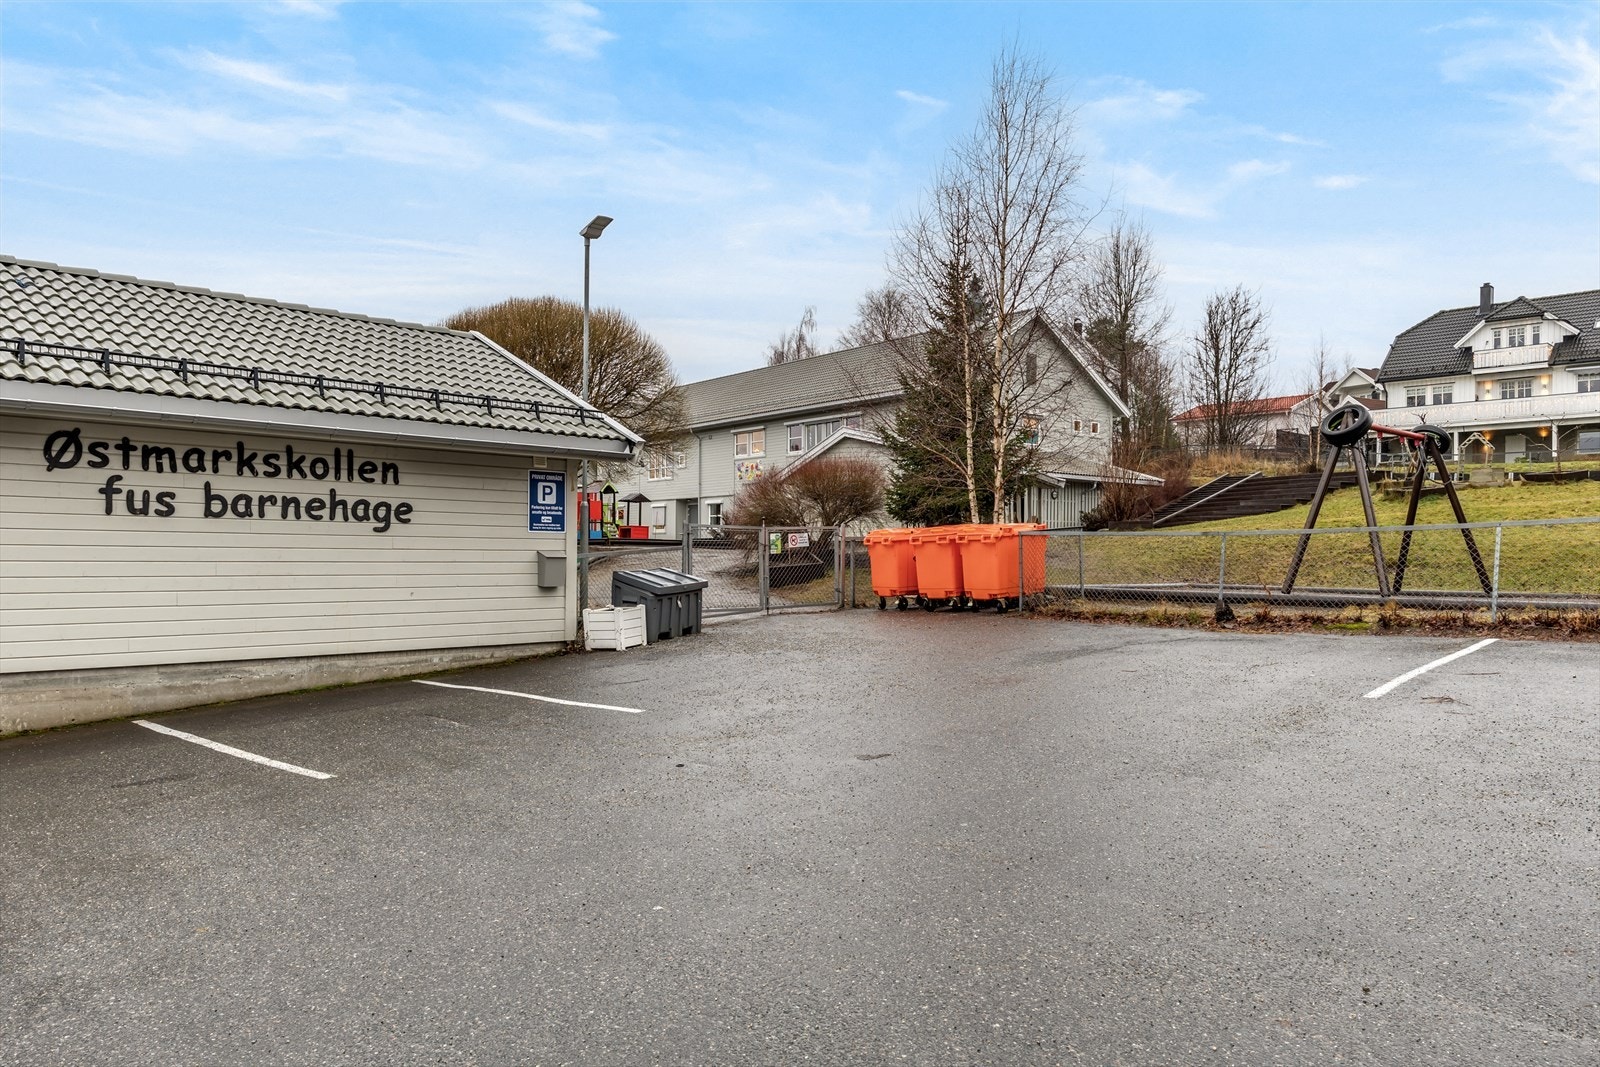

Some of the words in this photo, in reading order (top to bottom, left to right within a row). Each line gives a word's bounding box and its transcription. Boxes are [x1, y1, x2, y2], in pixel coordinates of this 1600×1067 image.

[43, 428, 400, 485] Østmarkskollen
[542, 484, 554, 502] P
[546, 474, 563, 482] OMRÅDE
[98, 474, 176, 518] fus
[203, 480, 413, 533] barnehage
